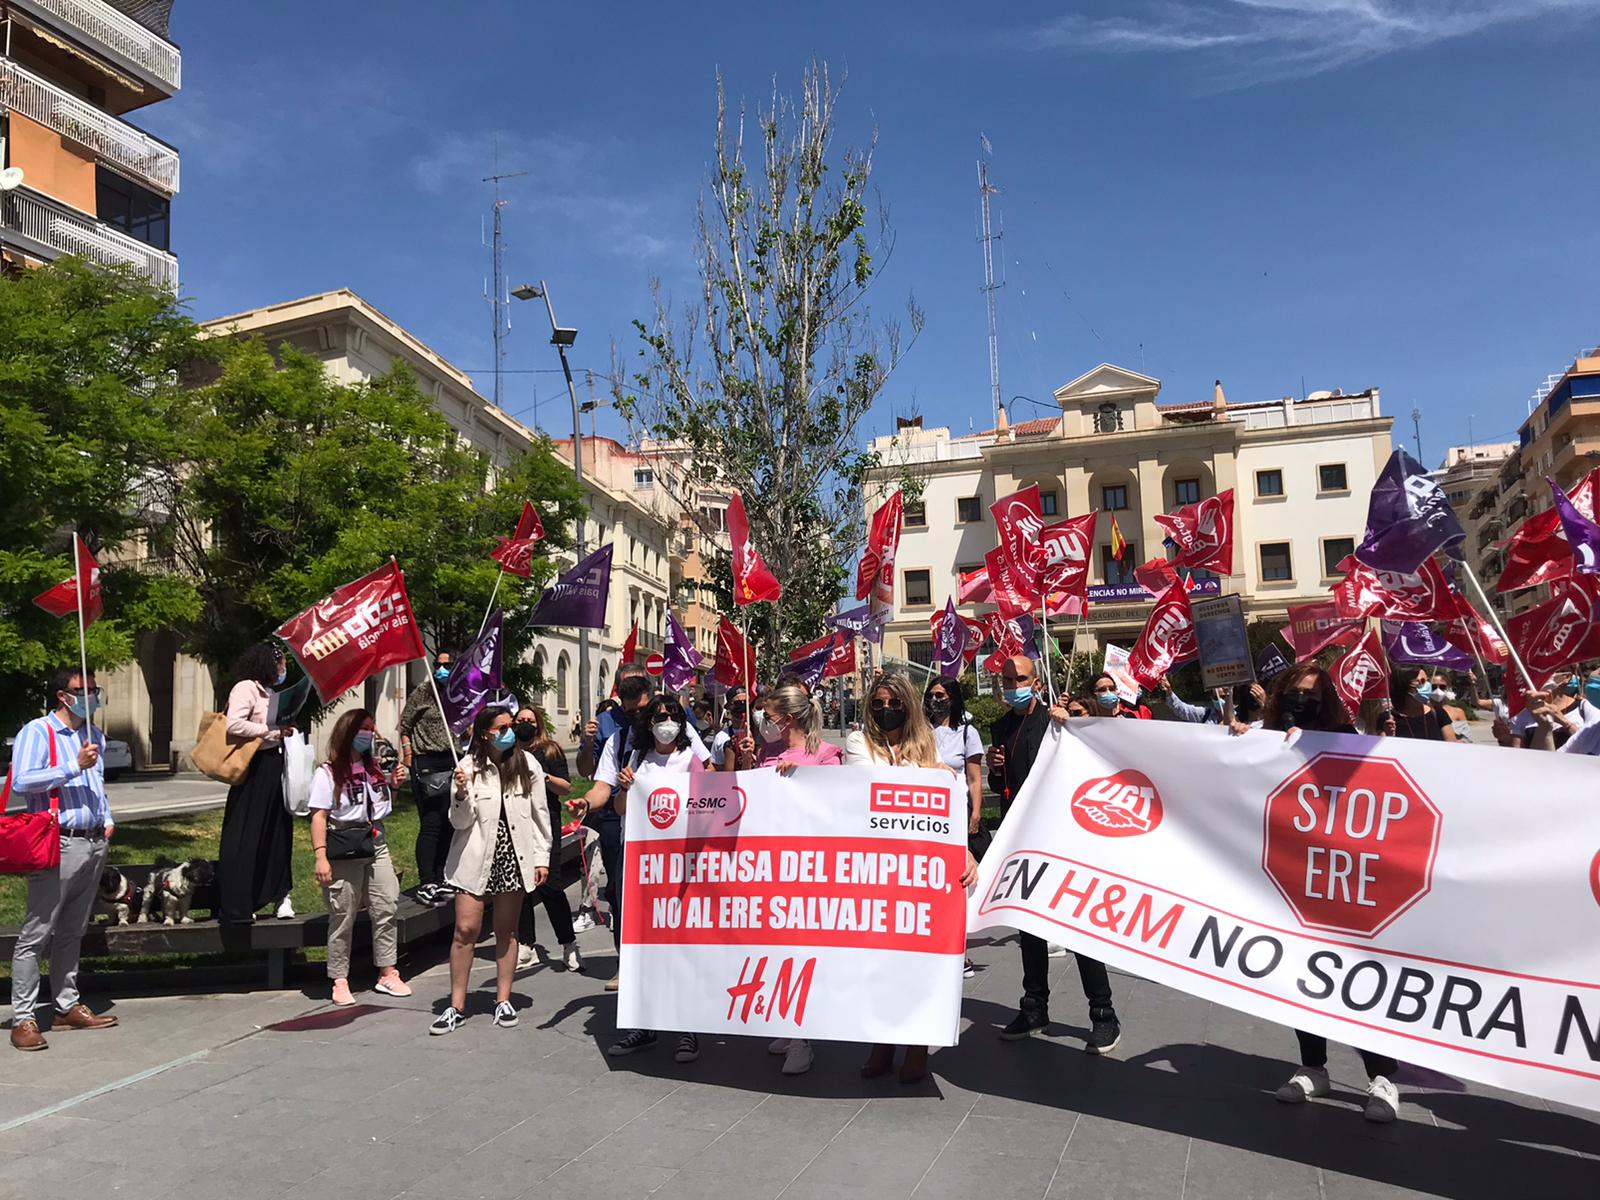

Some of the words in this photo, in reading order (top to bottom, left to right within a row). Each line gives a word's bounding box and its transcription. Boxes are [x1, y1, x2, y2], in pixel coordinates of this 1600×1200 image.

[1116, 587, 1128, 596] NO
[650, 793, 678, 809] UGT
[686, 797, 727, 809] FeSMC
[876, 789, 946, 811] CCOO
[1085, 779, 1155, 821] UGT
[1293, 783, 1409, 841] STOP
[870, 815, 950, 835] servicios
[639, 854, 664, 885] EN
[669, 850, 773, 885] DEFENSA
[779, 851, 828, 884] DEL
[835, 851, 952, 893] EMPLEO,
[1304, 846, 1380, 907] ERE
[652, 897, 681, 929] NO
[686, 897, 713, 929] AL
[719, 897, 763, 929] ERE
[768, 895, 887, 933] SALVAJE
[895, 901, 931, 936] DE
[990, 858, 1050, 903] EN
[1048, 870, 1185, 949] H&M
[1189, 915, 1284, 979] NO
[1296, 950, 1527, 1049] SOBRA
[726, 956, 817, 1027] H&M
